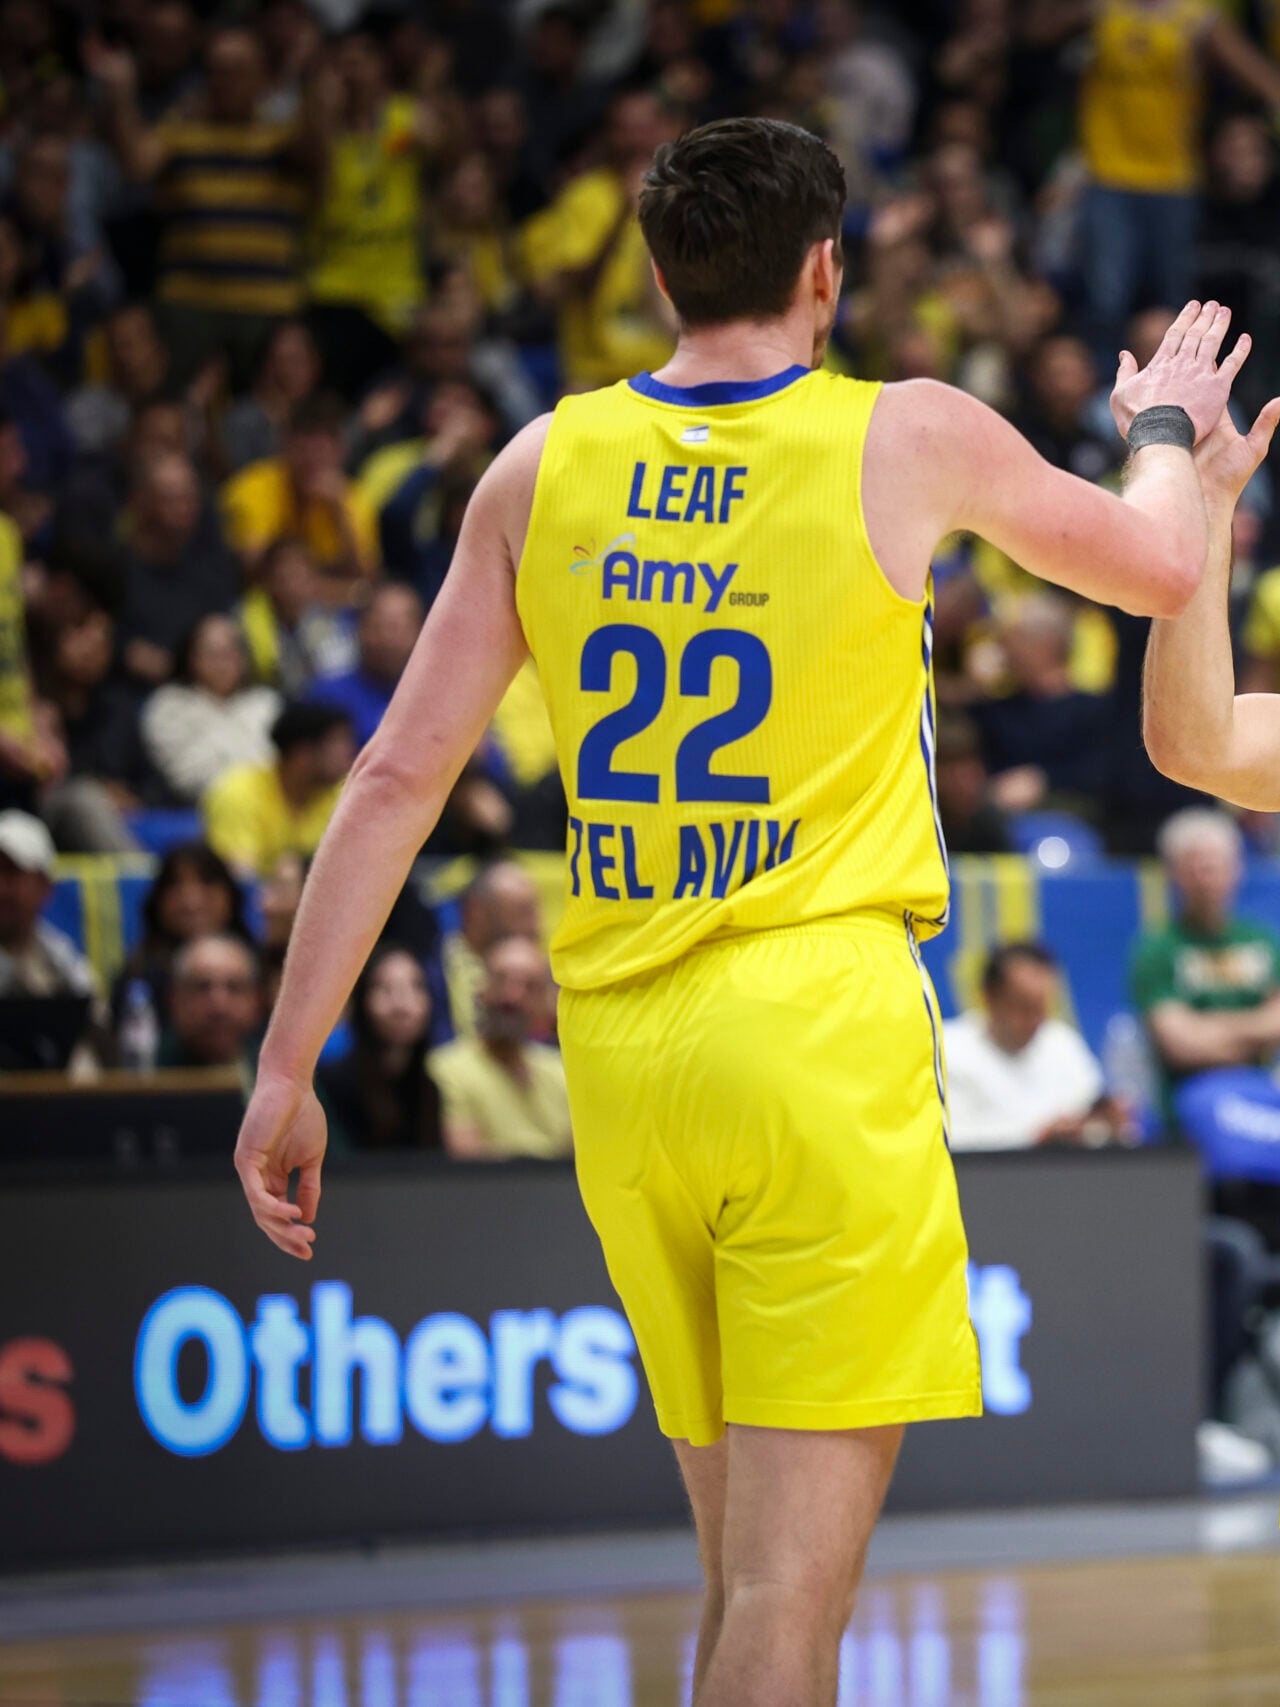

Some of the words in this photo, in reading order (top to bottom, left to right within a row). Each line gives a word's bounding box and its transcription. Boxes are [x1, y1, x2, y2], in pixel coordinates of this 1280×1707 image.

[627, 462, 748, 524] LEAF
[602, 550, 739, 614] Amy
[729, 592, 770, 607] GROUP
[577, 623, 772, 805] 22
[568, 816, 654, 901] TEL
[133, 1279, 640, 1458] Others
